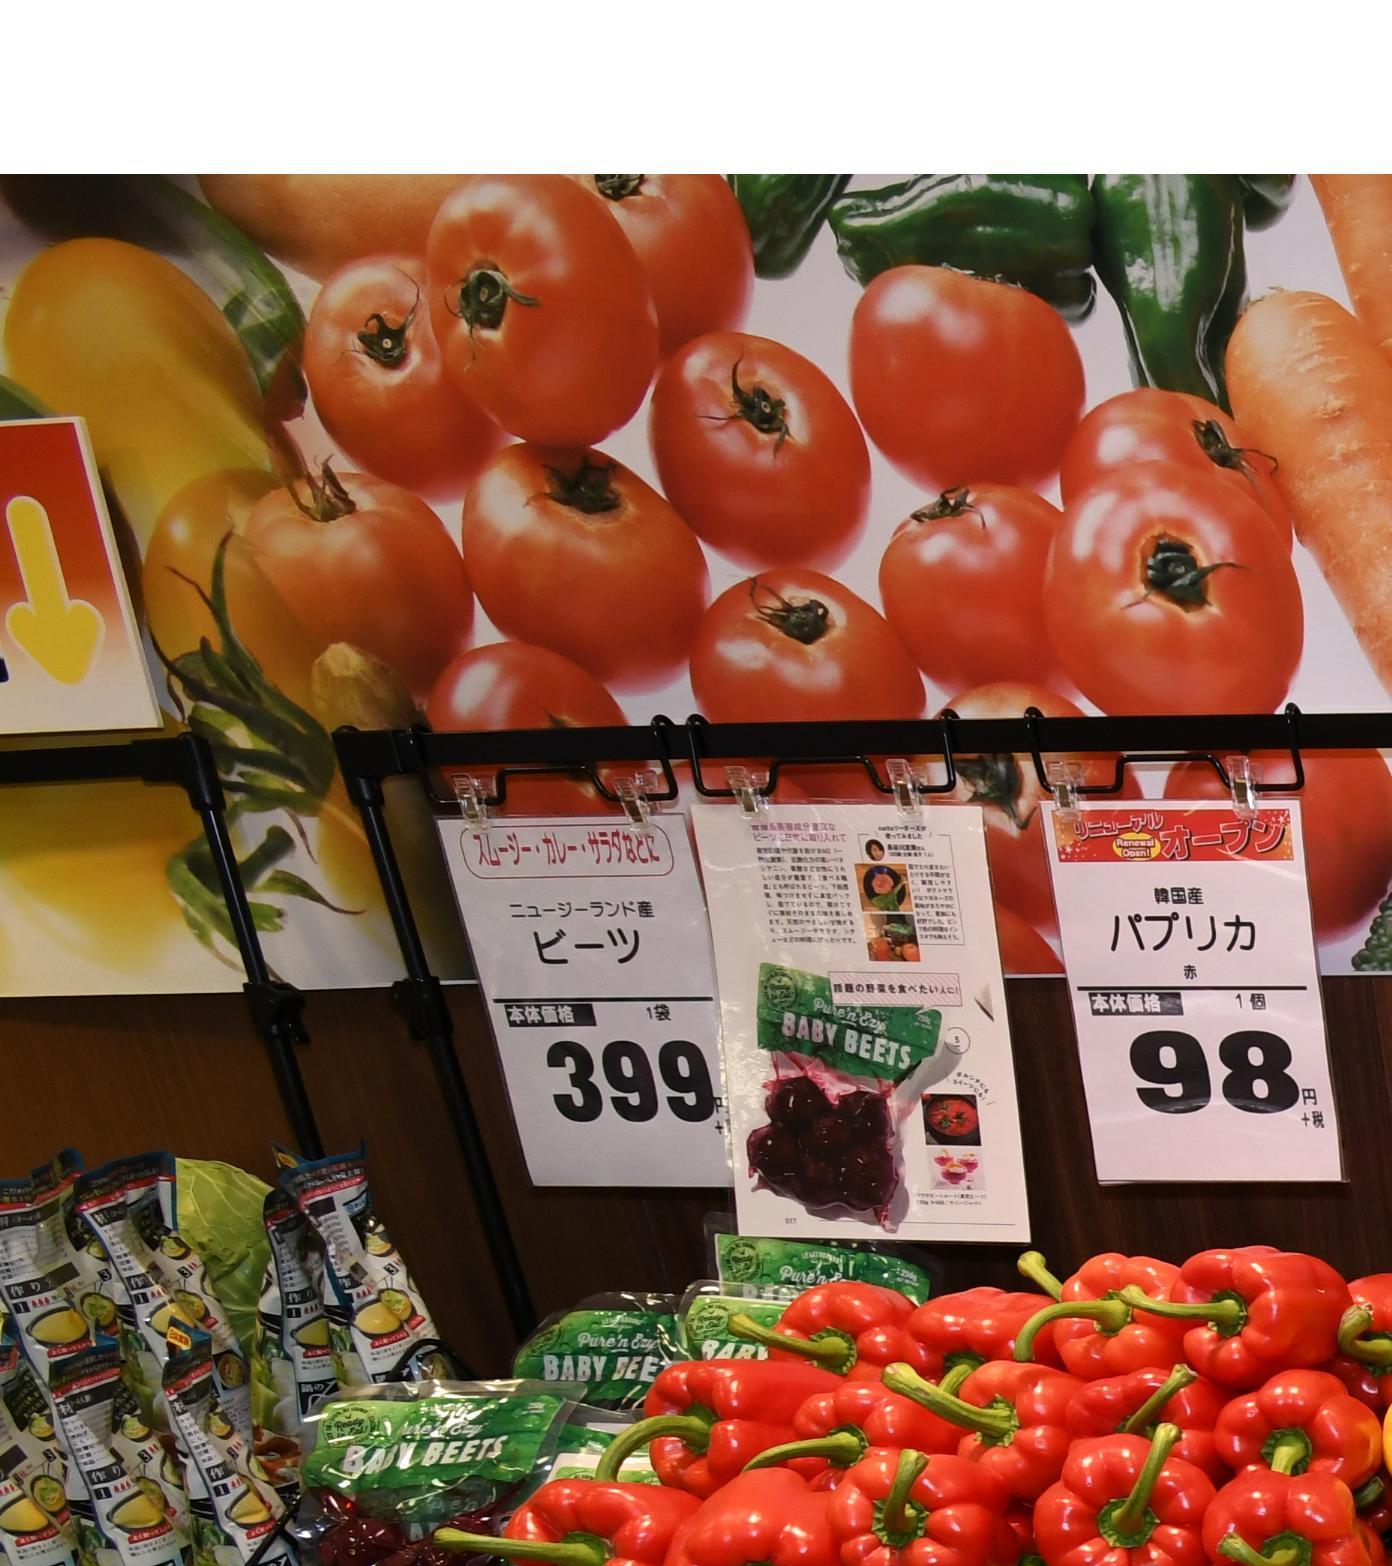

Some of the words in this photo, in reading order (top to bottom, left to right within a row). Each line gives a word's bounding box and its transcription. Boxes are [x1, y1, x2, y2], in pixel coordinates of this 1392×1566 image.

[1116, 838, 1155, 848] Renewal
[1160, 818, 1287, 861] オープン
[1154, 887, 1204, 905] 韓国産
[510, 901, 655, 919] ニュージーランド産
[1110, 914, 1256, 952] パプリカ
[533, 928, 640, 965] ビーツ
[1183, 964, 1198, 980] 赤
[507, 1005, 575, 1024] 本体価格
[646, 1005, 671, 1022] 1袋
[1092, 994, 1162, 1014] 本体価格
[782, 1012, 838, 1047] BABY
[844, 1029, 912, 1069] BEETS
[545, 1039, 717, 1123] 399
[1128, 1030, 1301, 1114] 98
[1302, 1087, 1317, 1106] 円
[1301, 1110, 1325, 1129] +税
[542, 1355, 607, 1382] BABY
[420, 1436, 508, 1467] BEETS
